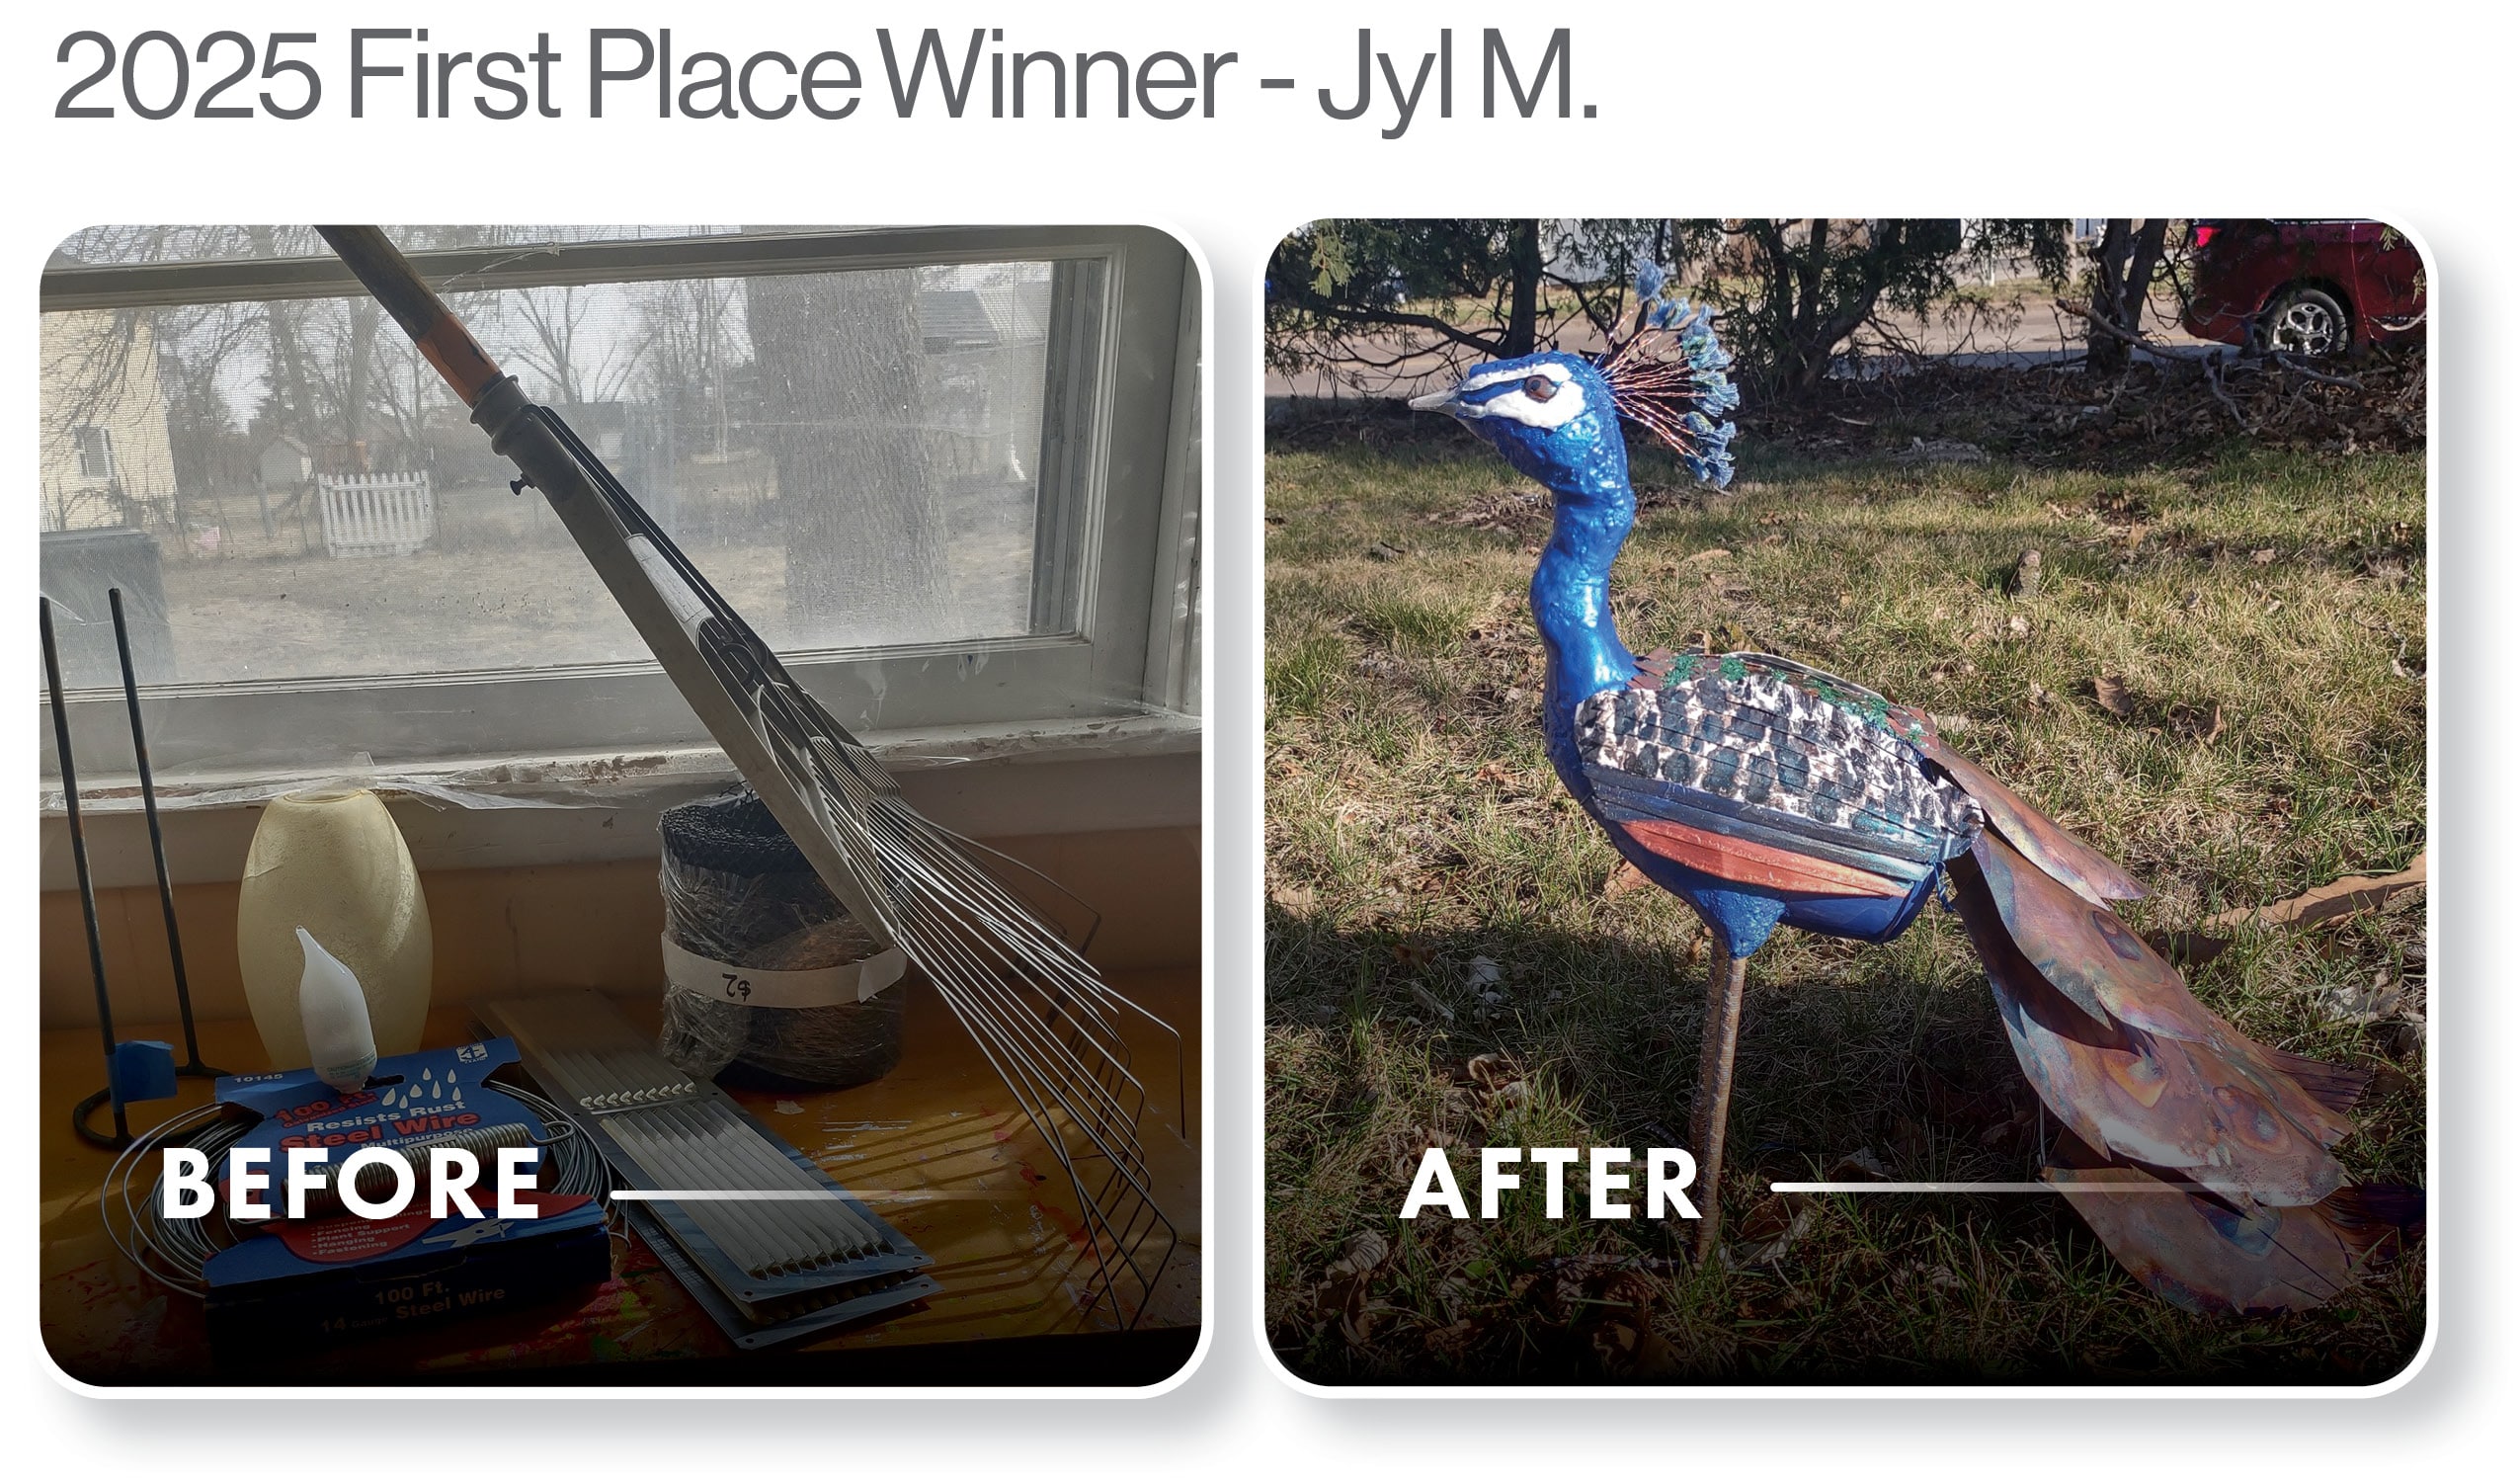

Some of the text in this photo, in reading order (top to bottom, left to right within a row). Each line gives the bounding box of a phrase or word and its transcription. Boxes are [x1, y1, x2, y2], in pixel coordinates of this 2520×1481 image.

[234, 1073, 284, 1083] 10145
[275, 1100, 331, 1124] 100
[306, 1101, 466, 1132] Resists Rust
[280, 1111, 481, 1153] Steel Wire
[361, 1127, 474, 1149] Multipurpose
[317, 1223, 411, 1243] Plant Support
[317, 1236, 375, 1248] Hanging
[318, 1241, 388, 1256] Fastening
[373, 1280, 449, 1305] 100 Ft.
[320, 1316, 347, 1334] 14
[395, 1295, 452, 1321] Steel
[457, 1287, 507, 1307] Wire
